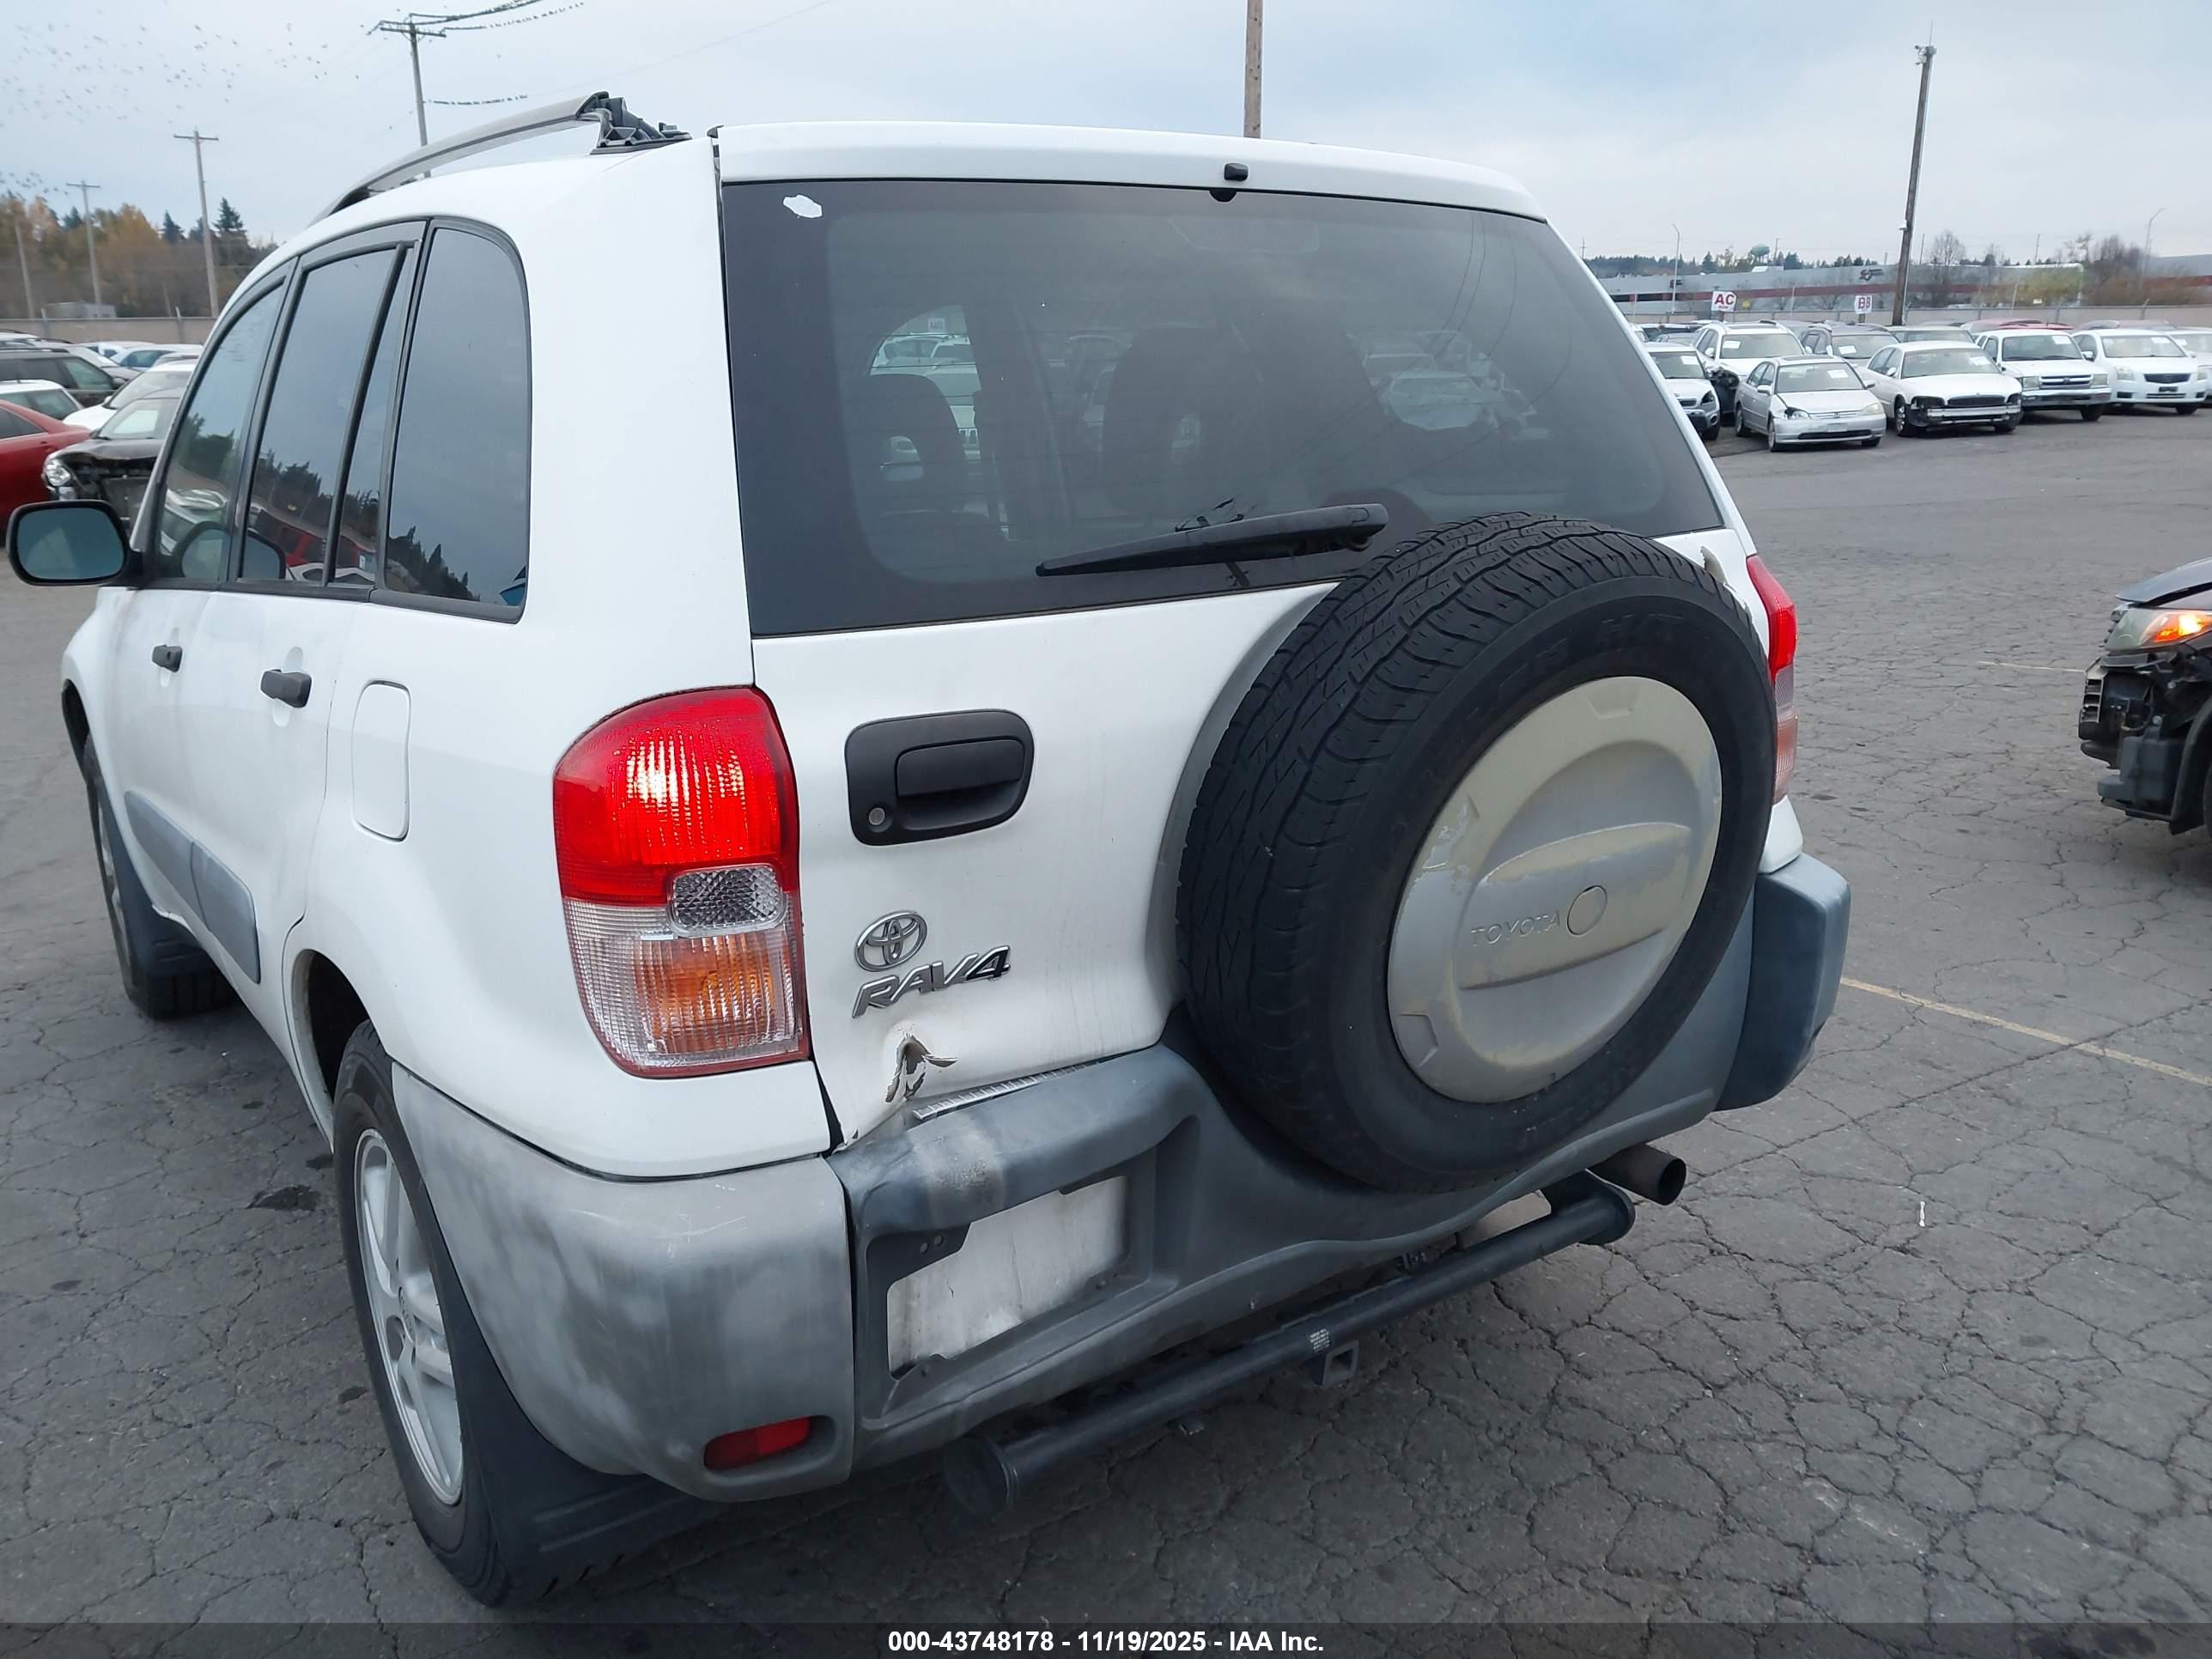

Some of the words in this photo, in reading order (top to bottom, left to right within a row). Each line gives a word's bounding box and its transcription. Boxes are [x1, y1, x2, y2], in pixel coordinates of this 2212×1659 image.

[1714, 293, 1735, 305] AC
[1470, 910, 1560, 947] TOYOTA
[851, 945, 1011, 1019] RAV4
